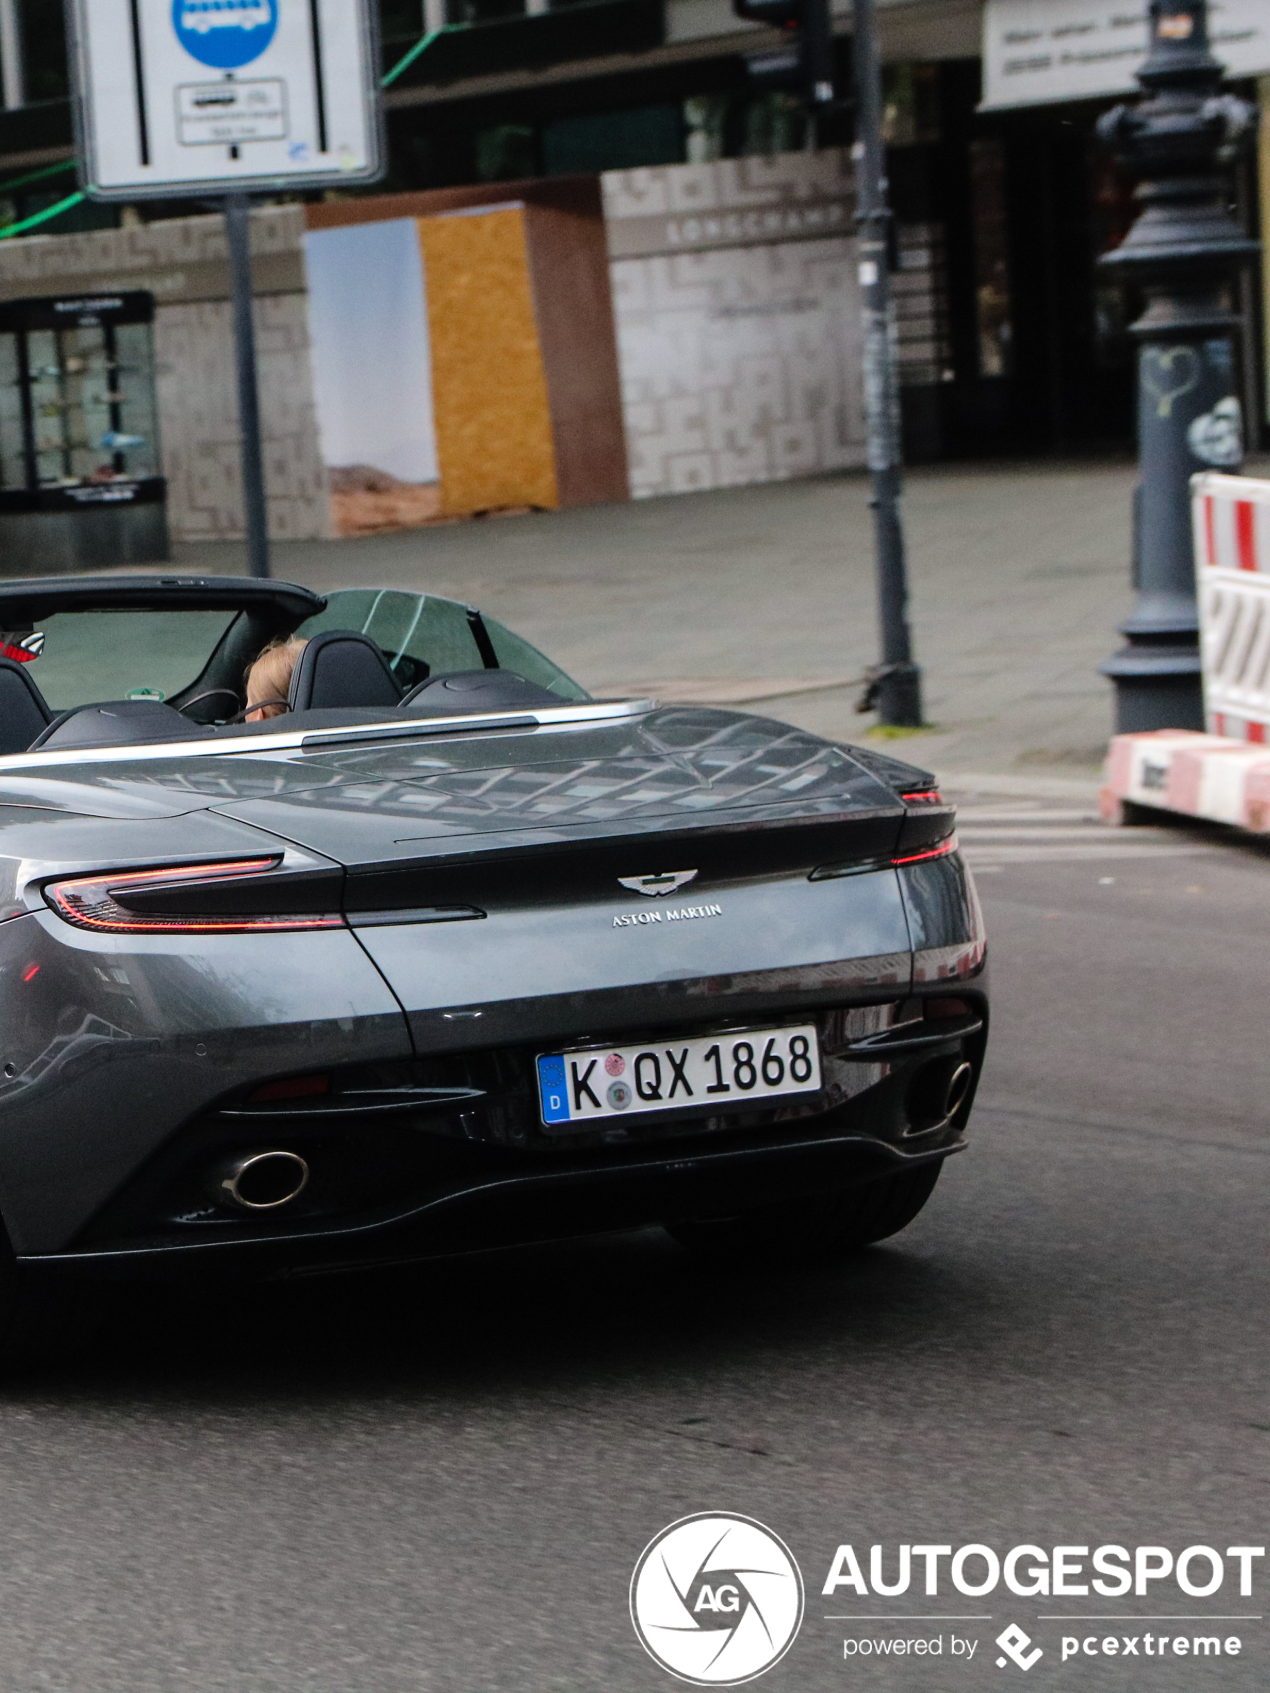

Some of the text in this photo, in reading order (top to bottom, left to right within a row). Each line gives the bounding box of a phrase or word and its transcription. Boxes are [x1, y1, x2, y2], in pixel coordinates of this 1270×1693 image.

[612, 904, 723, 929] ASTON MARTIN
[571, 1035, 813, 1110] K QX 1868
[550, 1095, 561, 1110] D
